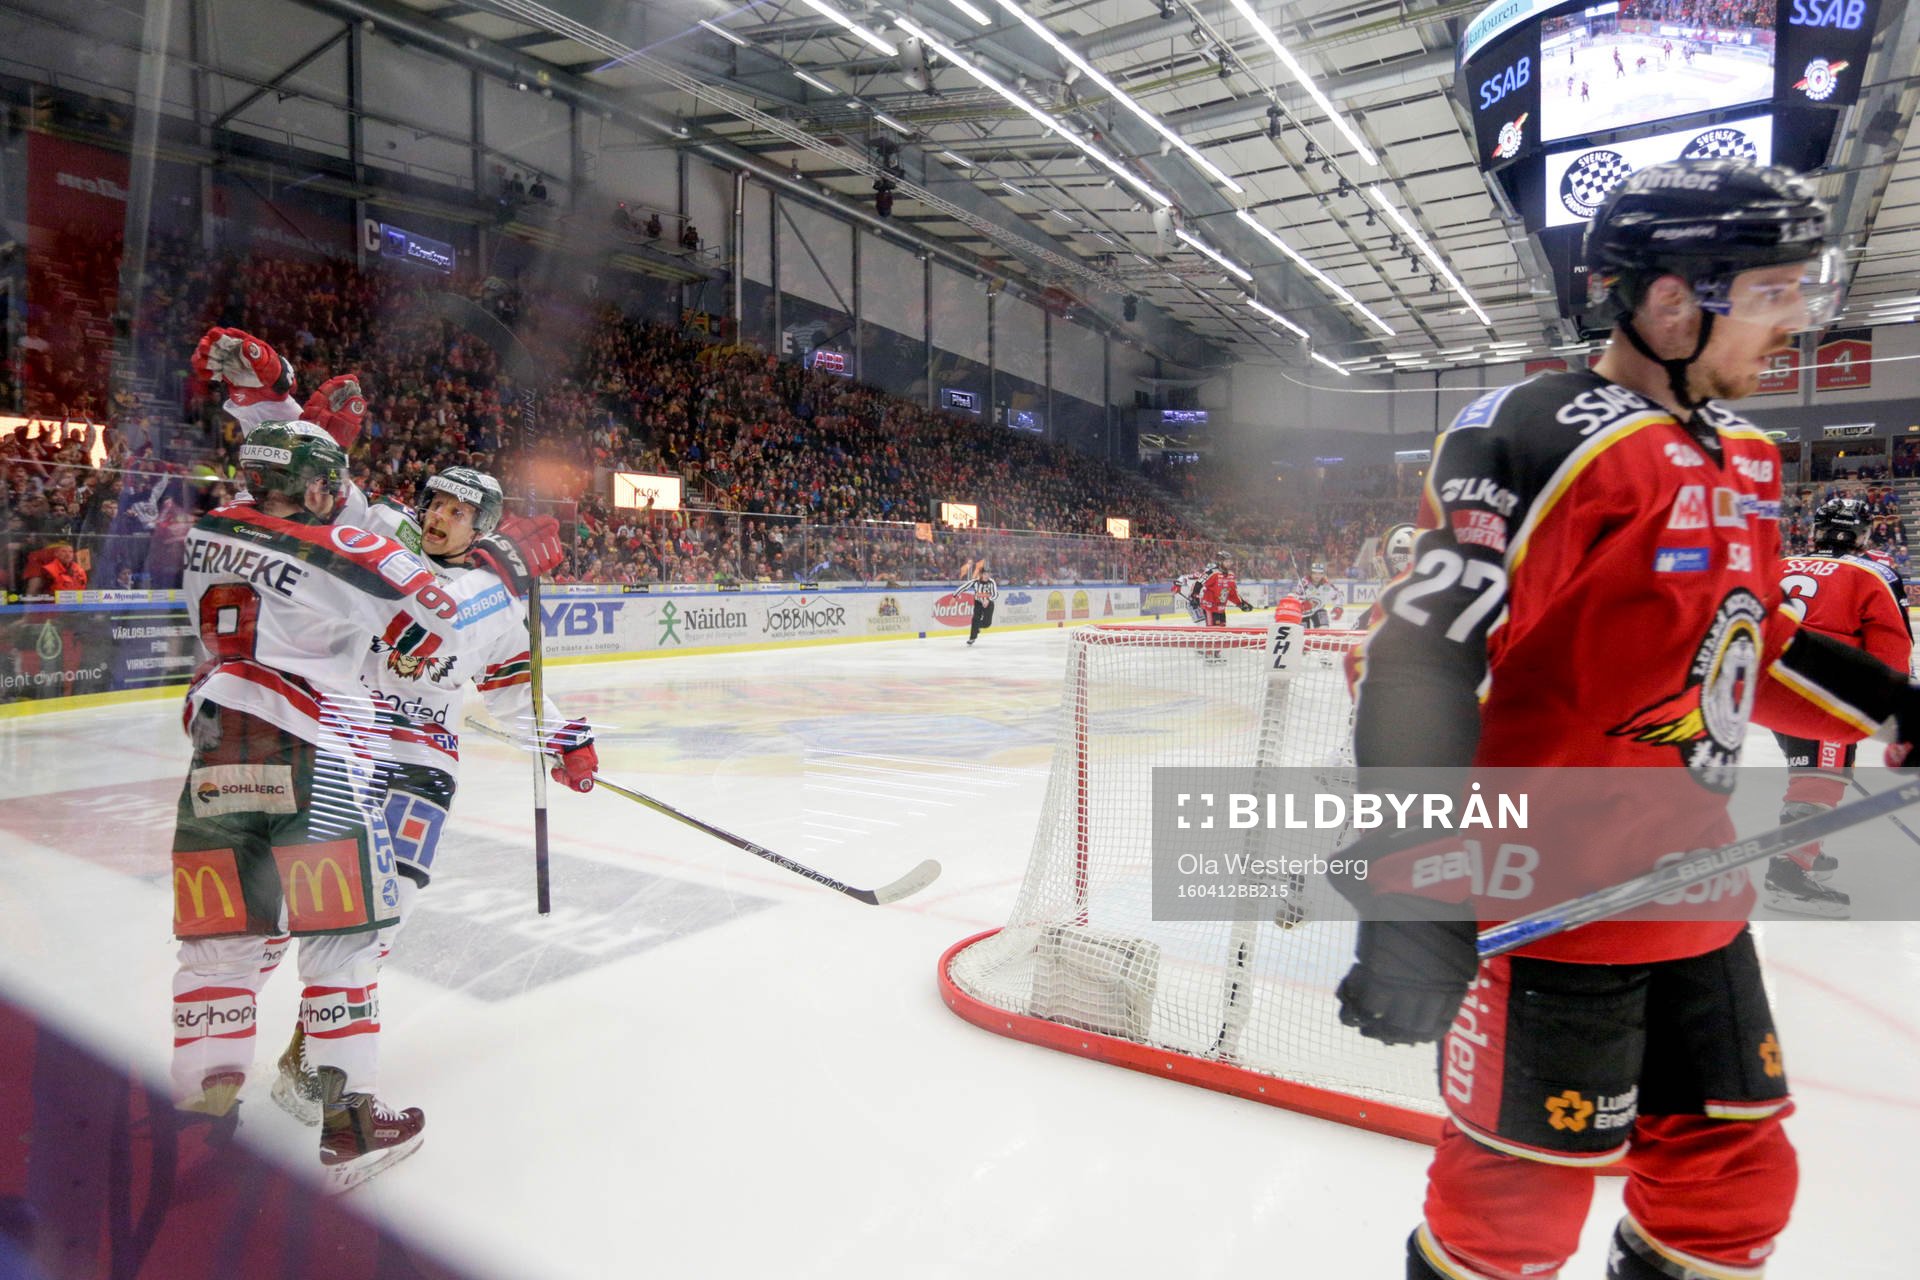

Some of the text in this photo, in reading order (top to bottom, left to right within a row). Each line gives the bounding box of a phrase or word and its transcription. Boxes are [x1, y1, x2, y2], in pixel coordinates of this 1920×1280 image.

[1480, 56, 1530, 110] SSAB
[1695, 129, 1736, 147] SVENSK
[1577, 151, 1613, 168] SVENSK
[364, 219, 380, 251] C
[782, 331, 793, 354] E
[814, 351, 844, 372] ABB
[1834, 350, 1851, 374] 4
[241, 446, 289, 462] URFORS
[432, 479, 479, 500] BJURFORS
[1836, 532, 1845, 541] 6
[1783, 559, 1840, 576] SSAB
[415, 584, 458, 620] 9
[1392, 548, 1508, 644] 27
[1273, 626, 1291, 669] SHL
[743, 842, 848, 893] EASTON
